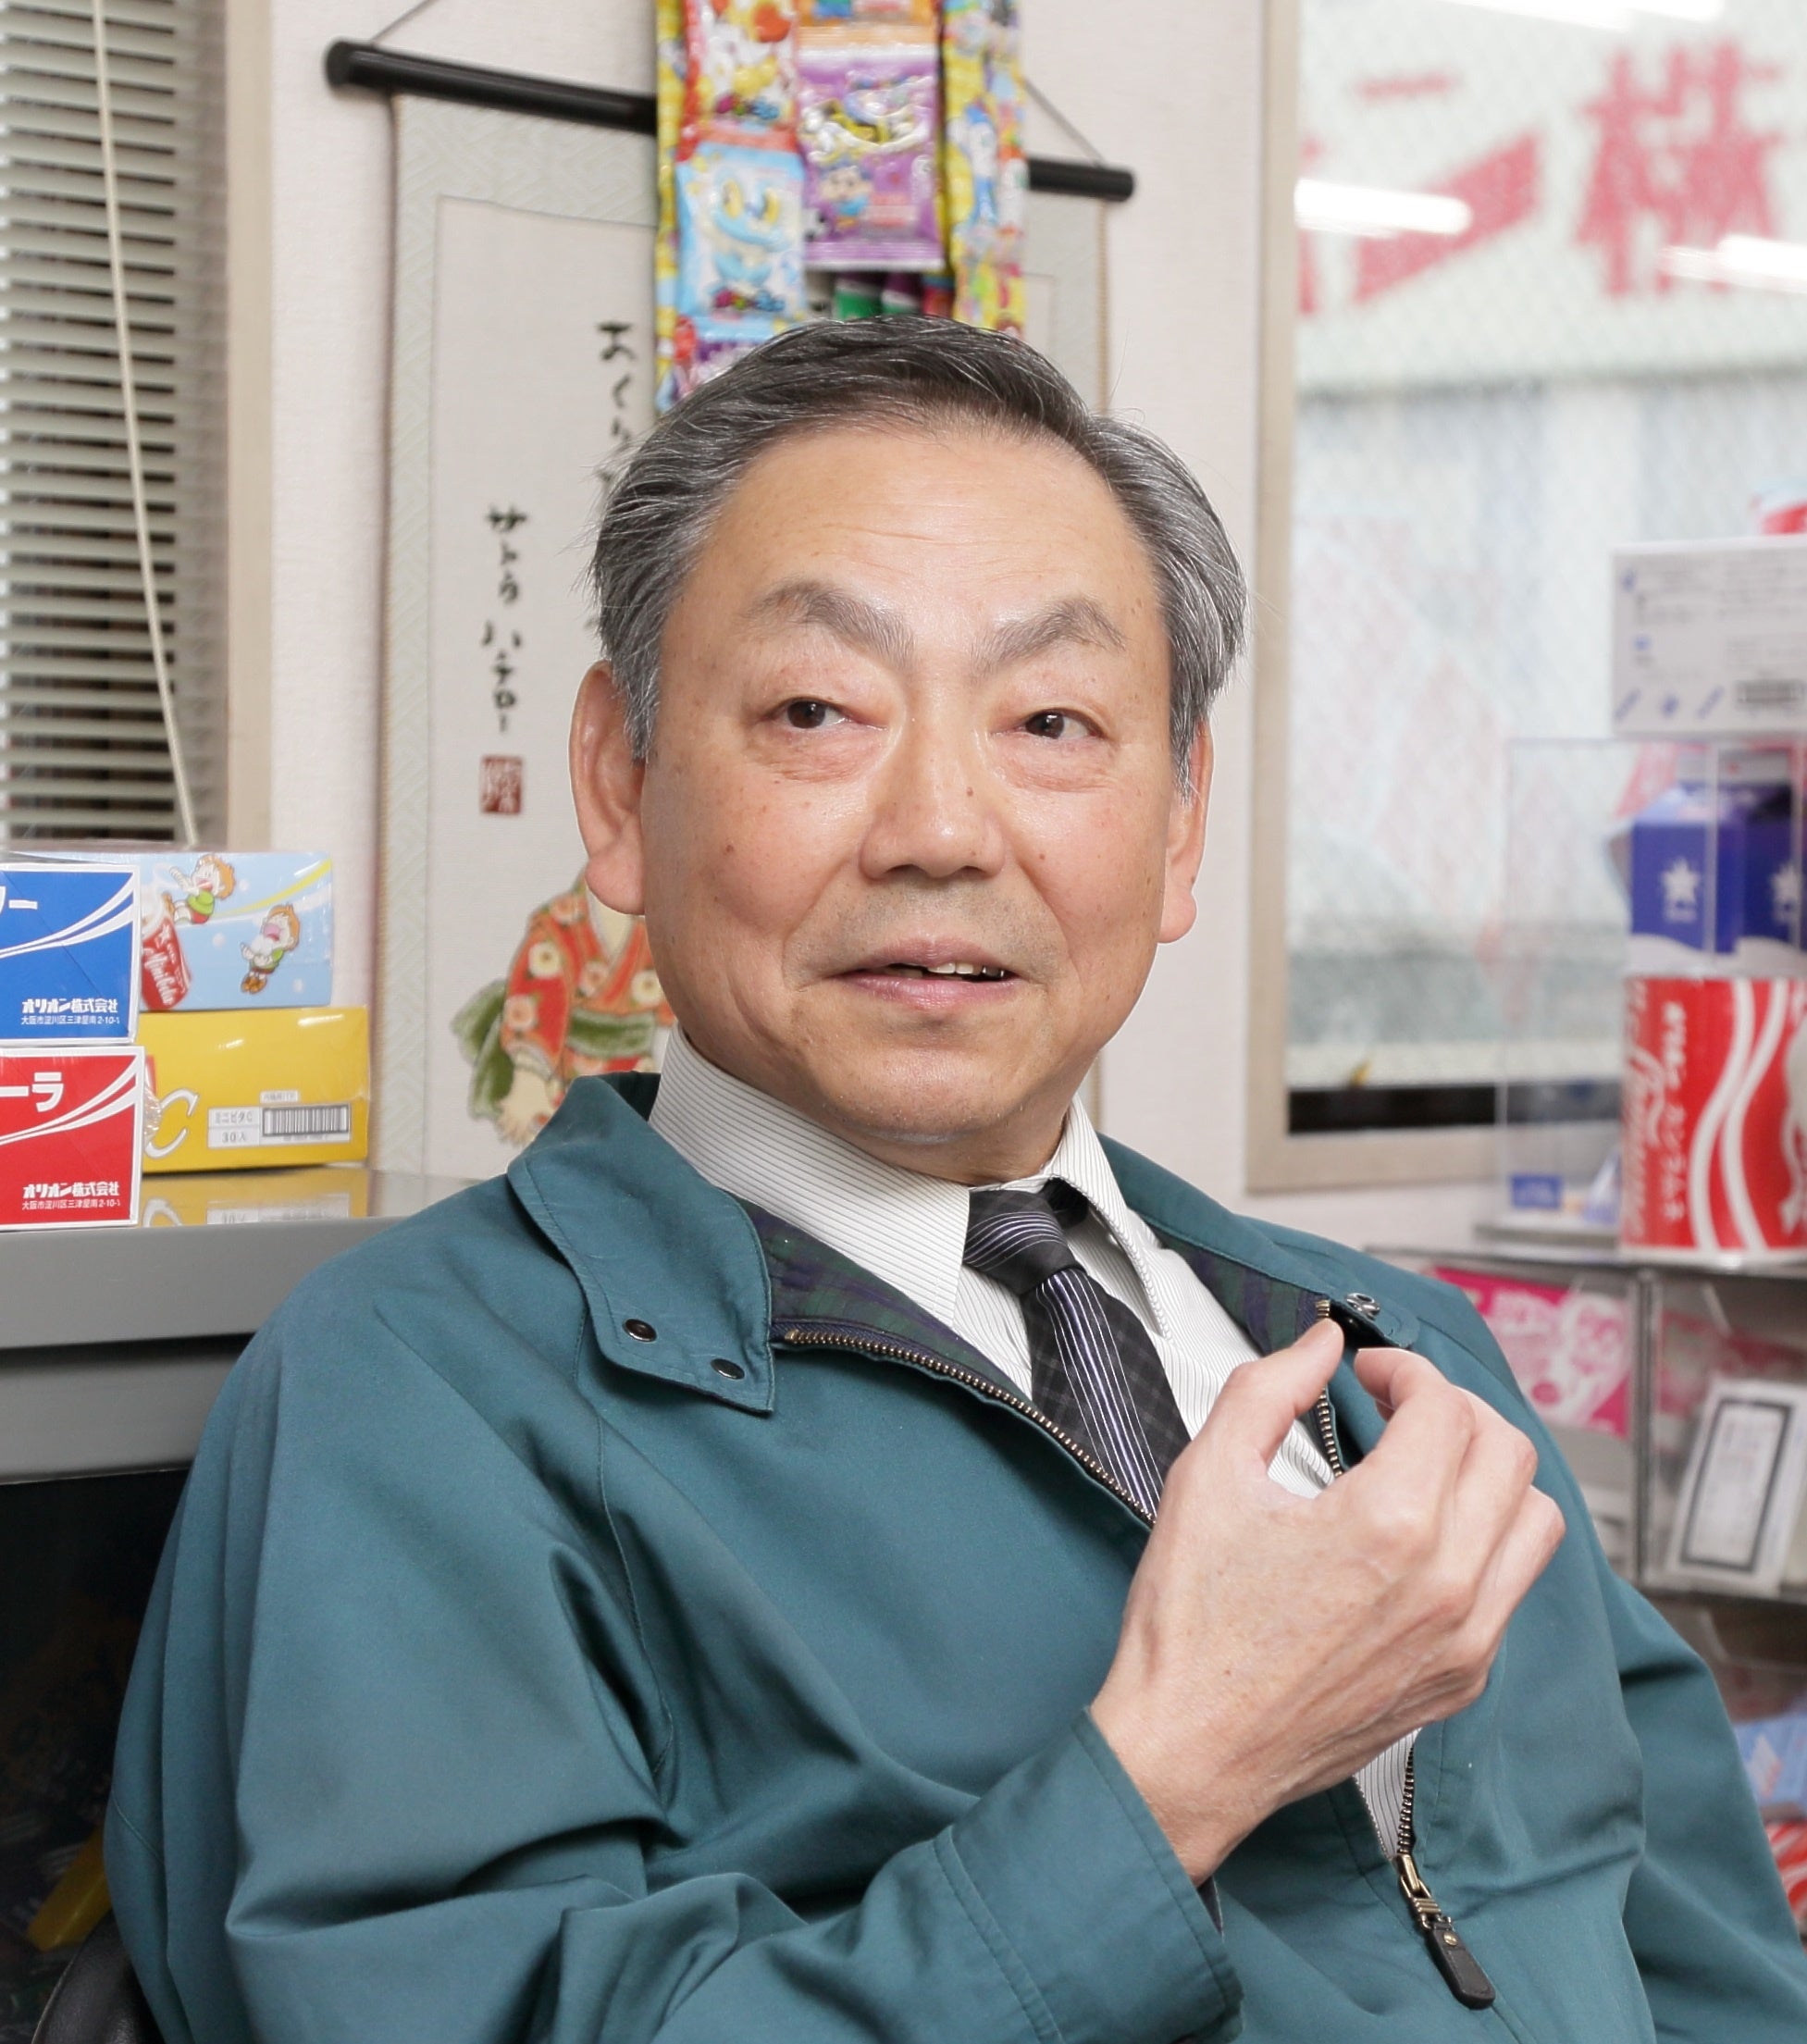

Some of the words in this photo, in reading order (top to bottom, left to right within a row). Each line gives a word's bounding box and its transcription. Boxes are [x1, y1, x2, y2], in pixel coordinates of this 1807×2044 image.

[1299, 37, 1784, 315] ン株
[21, 998, 118, 1014] オリオン株式会社
[22, 1182, 119, 1199] オリオン株式会社
